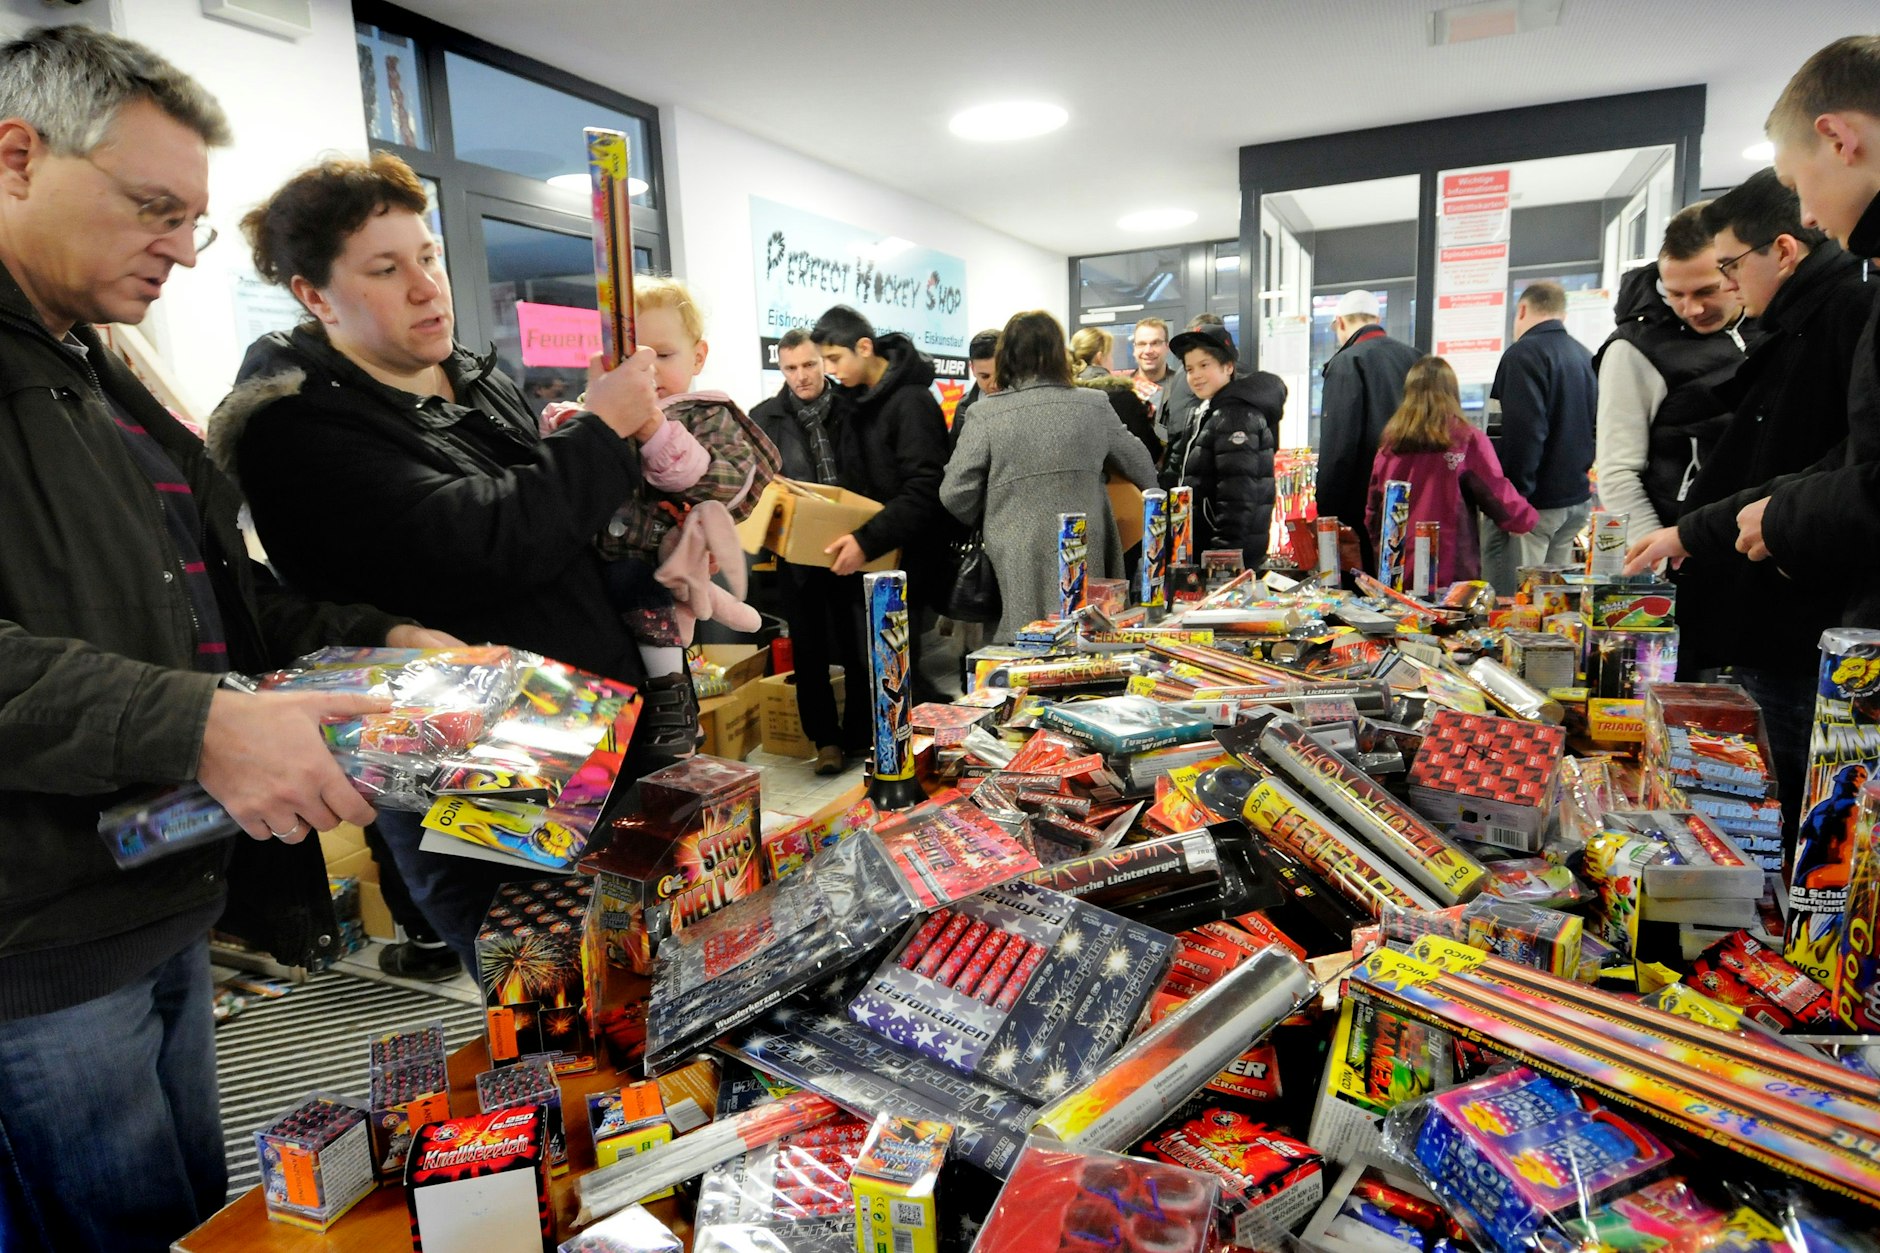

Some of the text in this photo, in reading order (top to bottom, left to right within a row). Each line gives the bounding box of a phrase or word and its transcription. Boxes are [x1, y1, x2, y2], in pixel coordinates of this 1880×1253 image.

[767, 309, 815, 329] Eishocke
[924, 330, 965, 348] Eiskunstlauf
[1306, 686, 1360, 697] Lichterorgel
[1177, 772, 1197, 784] NICO
[439, 799, 464, 827] NICO
[1249, 788, 1271, 814] NICO
[698, 825, 752, 873] STEPS
[722, 857, 739, 881] TO
[1107, 857, 1181, 884] Lichterorgel
[1445, 865, 1470, 889] NICO
[675, 876, 734, 929] HELL
[1081, 915, 1103, 928] NICO
[1246, 916, 1269, 935] 400
[1128, 933, 1150, 945] NICO
[1179, 936, 1227, 960] CRACKER
[1442, 945, 1477, 965] NICO
[1395, 960, 1430, 979] NICO
[1793, 961, 1830, 979] NICO
[1838, 917, 1874, 1033] Gold
[714, 988, 782, 1031] Wunderkerzen
[873, 980, 991, 1043] Eisfontänen
[1460, 1026, 1483, 1045] 15
[1487, 1034, 1586, 1090] Leuchtkugeln
[1210, 1077, 1268, 1099] CRACKER
[1342, 1068, 1353, 1091] NICO
[505, 1112, 534, 1124] 250
[1009, 1104, 1033, 1133] SUPER
[423, 1134, 530, 1171] Knallteppich
[985, 1136, 1008, 1169] SUPER
